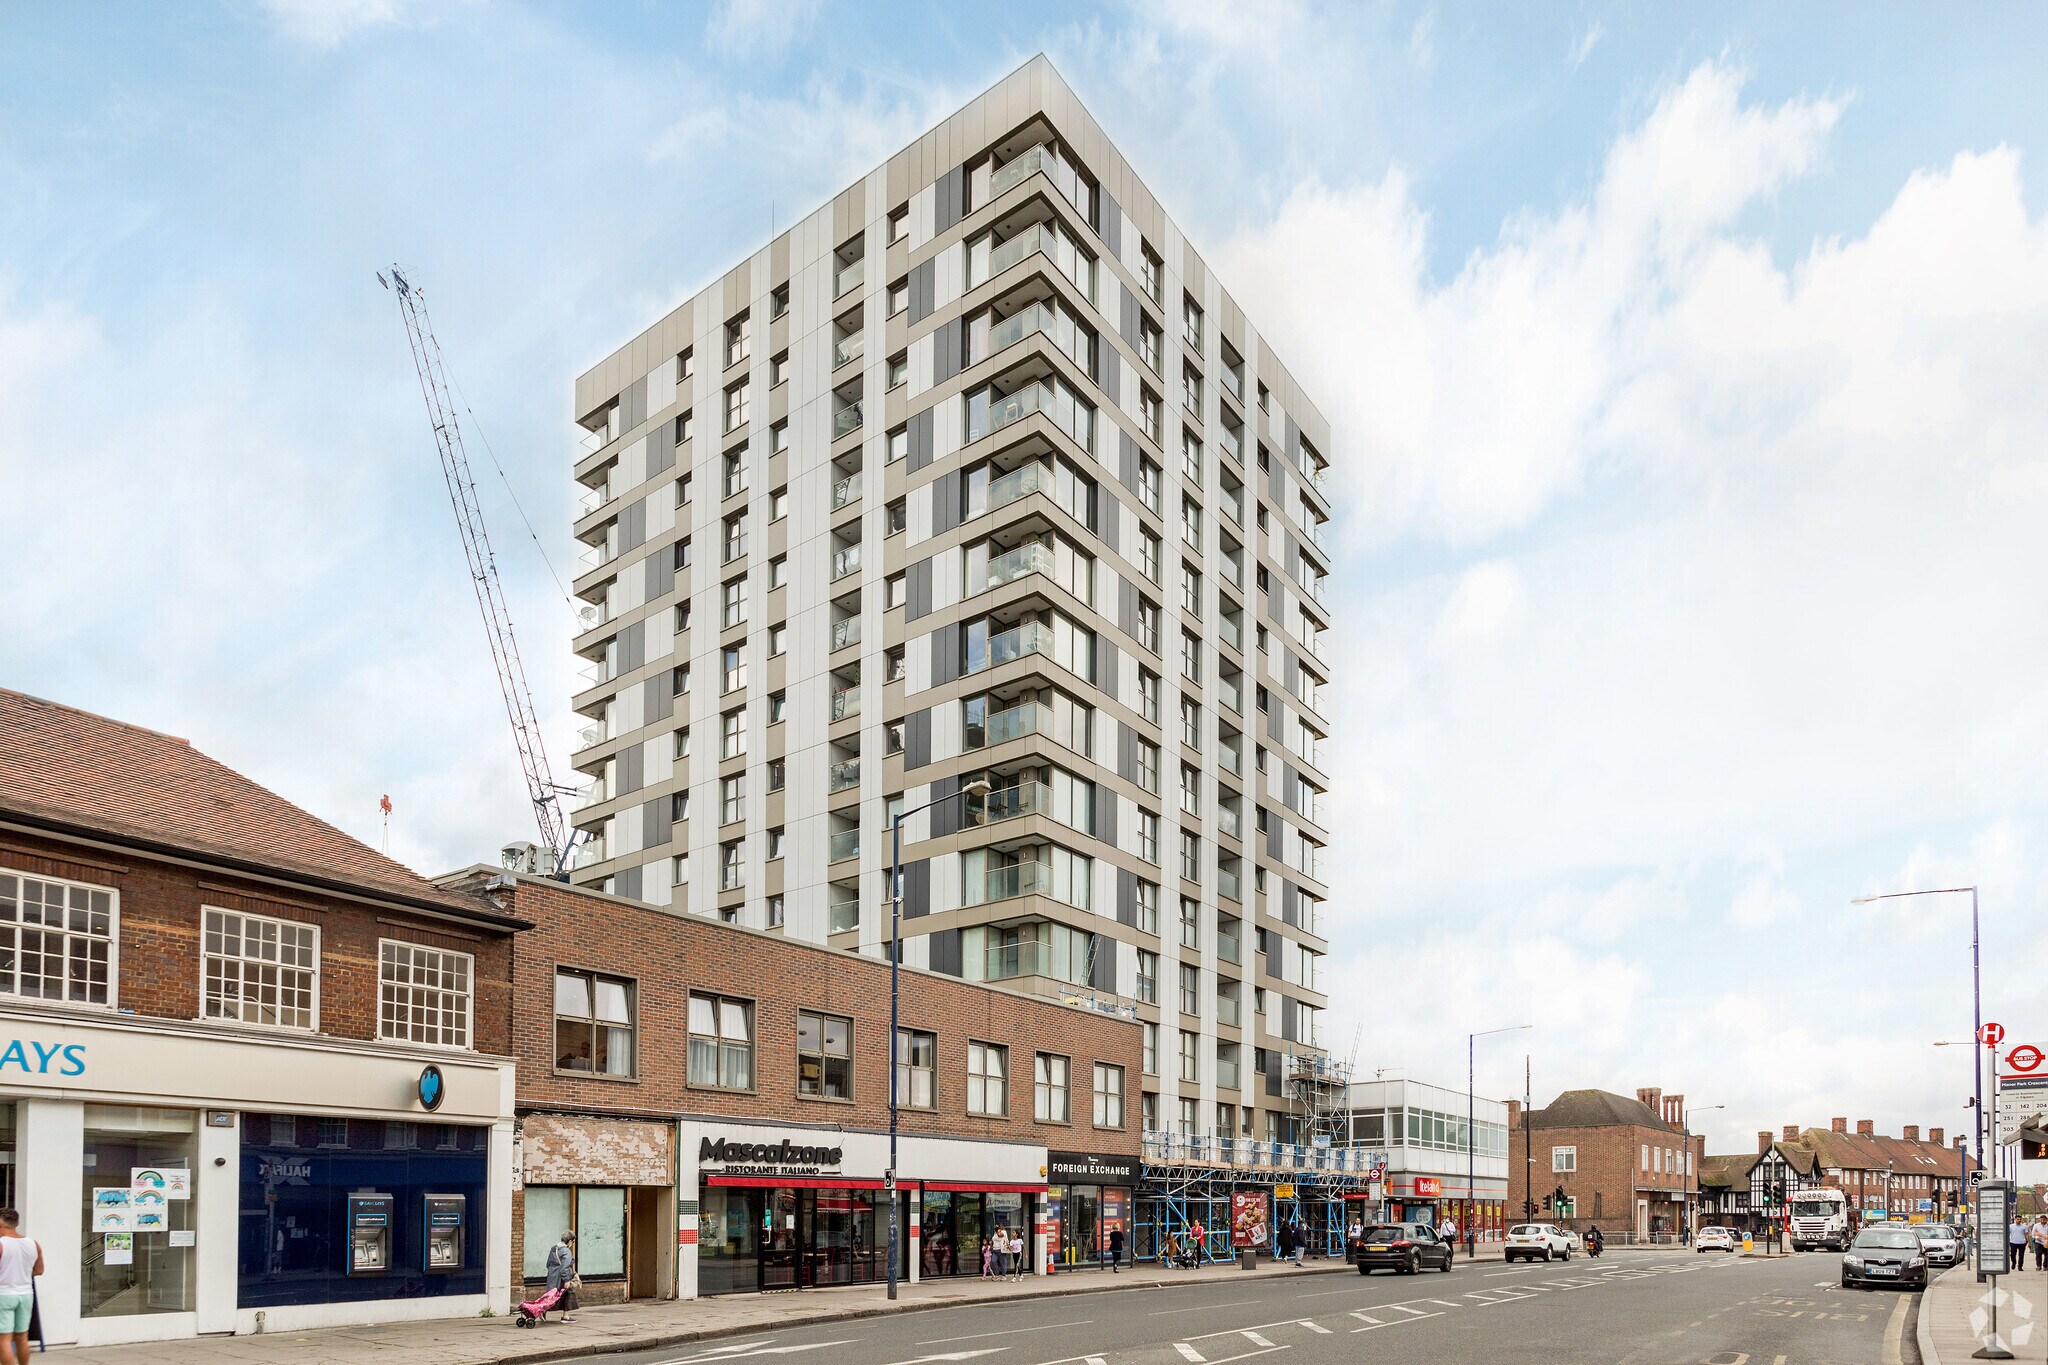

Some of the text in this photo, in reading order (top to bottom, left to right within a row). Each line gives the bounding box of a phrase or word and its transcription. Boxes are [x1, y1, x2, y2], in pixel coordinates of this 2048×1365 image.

[1983, 1025, 2000, 1042] H
[0, 1039, 86, 1077] AYS
[699, 1136, 843, 1165] Mascalzone
[725, 1165, 820, 1176] RISTORANTE ITALIANO
[1052, 1163, 1130, 1176] FOREIGN EXCHANGE
[1419, 1179, 1440, 1193] Iceland
[1236, 1195, 1246, 1207] 9
